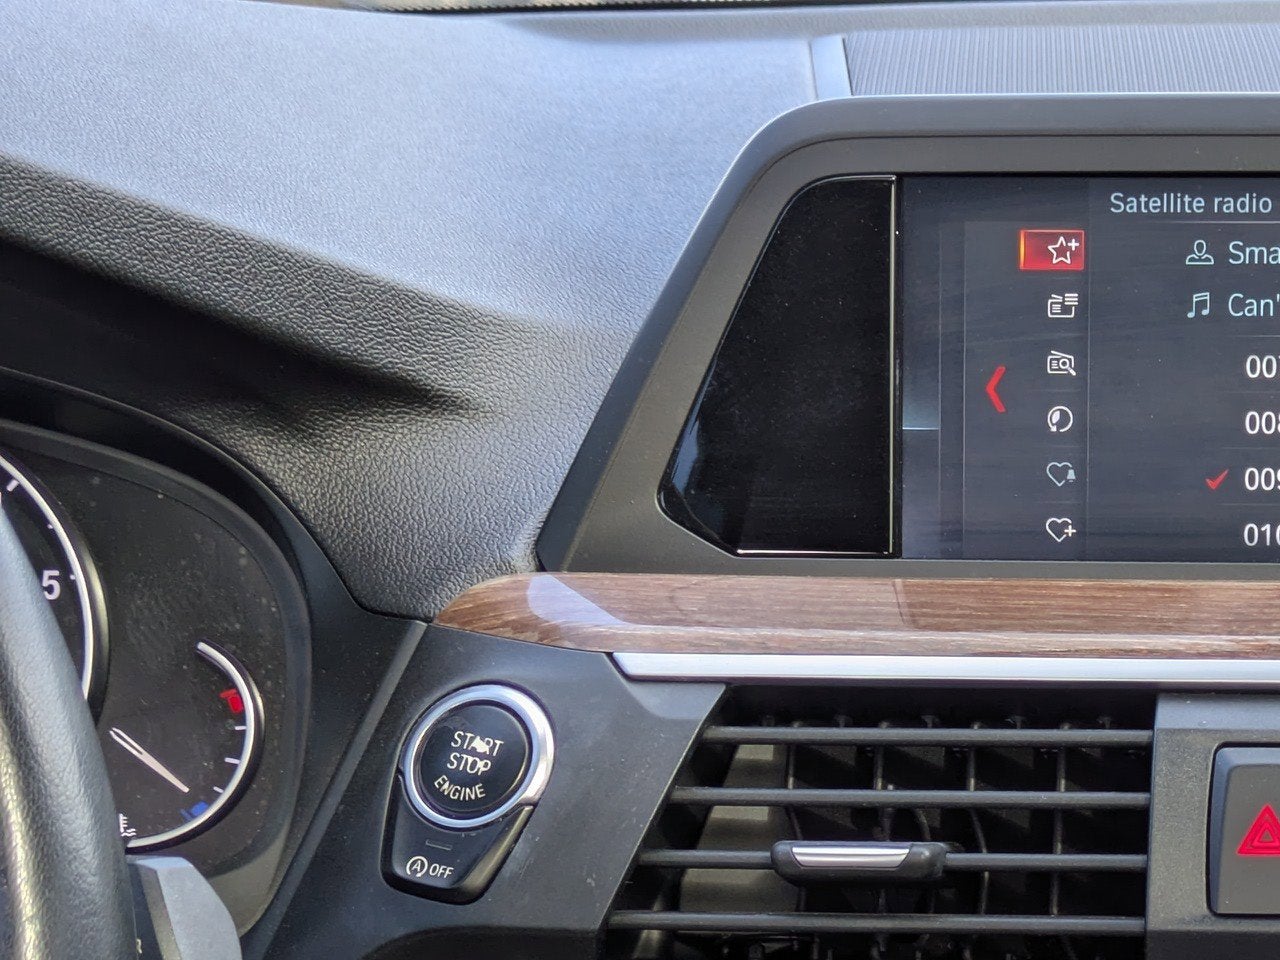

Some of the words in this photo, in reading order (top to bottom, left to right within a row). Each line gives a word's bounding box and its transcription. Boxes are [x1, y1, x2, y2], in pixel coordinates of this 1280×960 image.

[1110, 192, 1205, 214] Satellite
[1214, 192, 1272, 214] radio
[42, 569, 61, 600] 5
[451, 731, 504, 756] START
[447, 752, 491, 775] STOP
[434, 775, 486, 800] ENGINE
[429, 863, 454, 878] OFF
